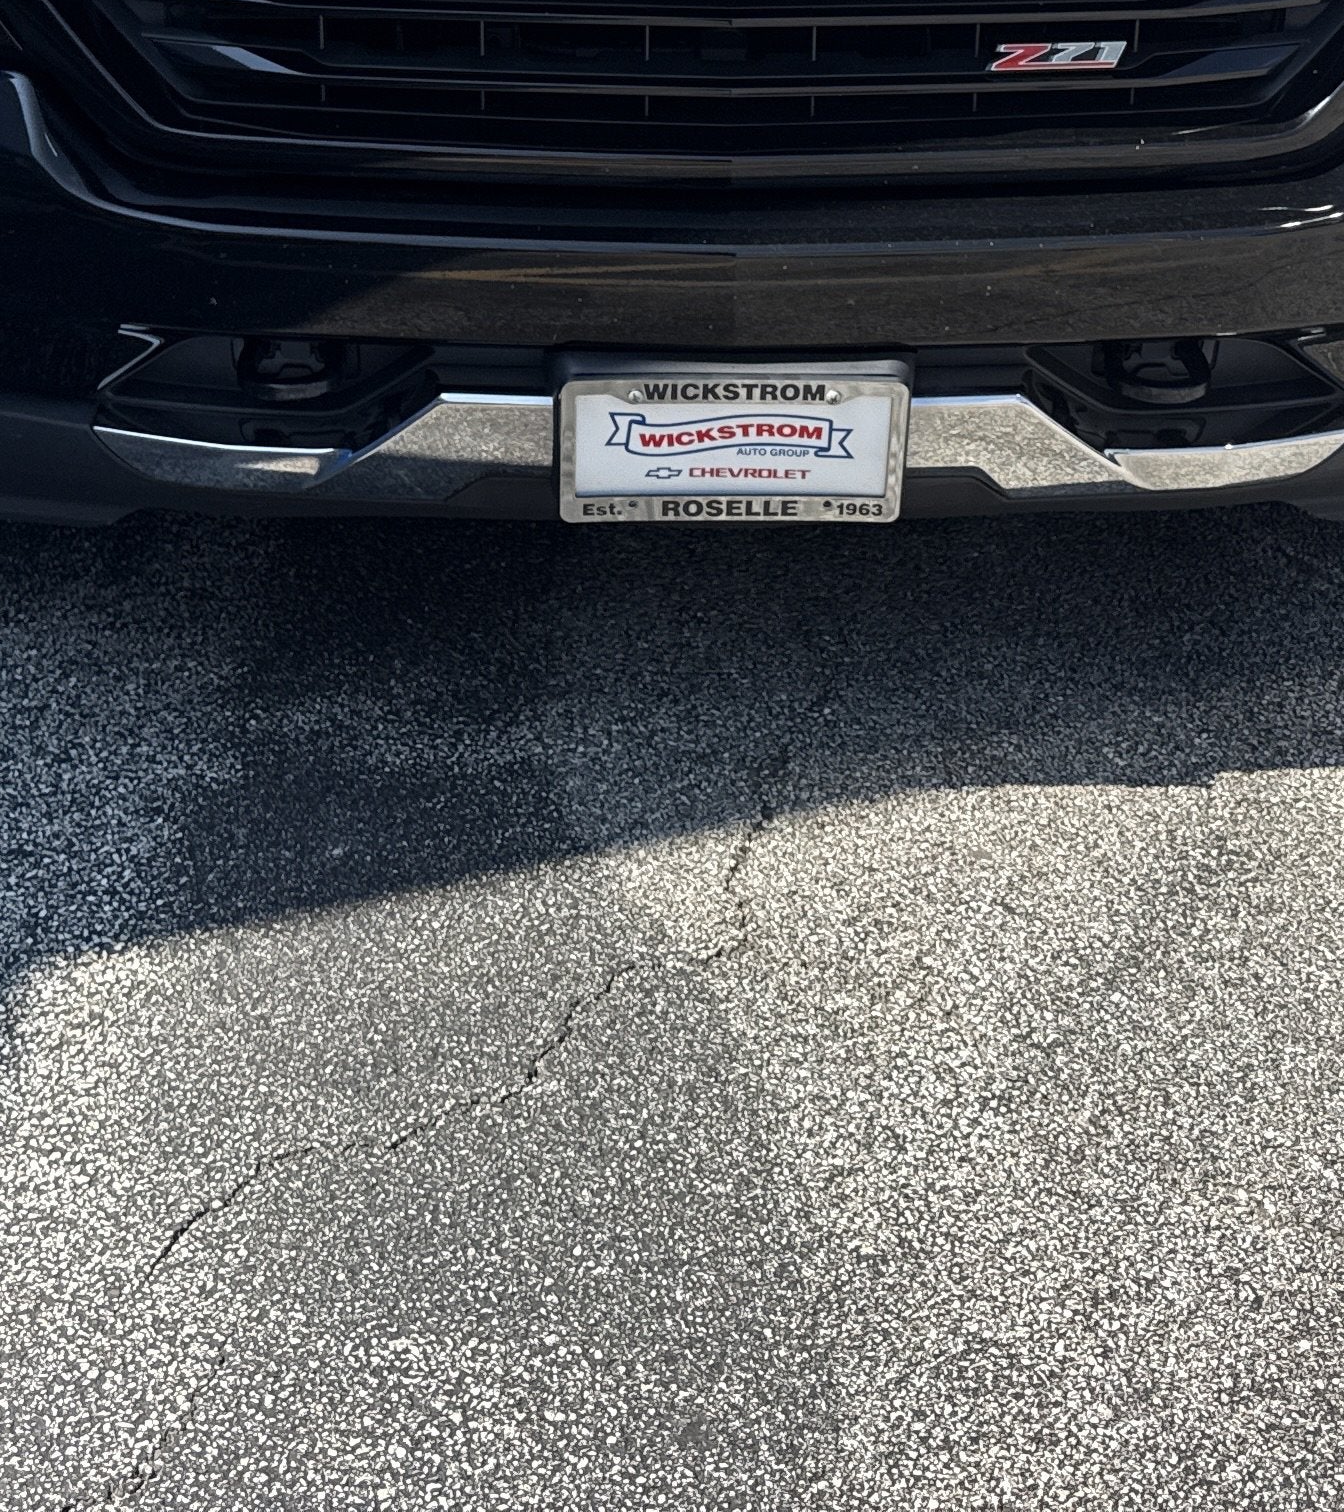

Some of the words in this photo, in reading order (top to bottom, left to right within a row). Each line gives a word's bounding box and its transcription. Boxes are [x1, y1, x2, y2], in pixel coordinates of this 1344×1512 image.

[986, 41, 1128, 71] Z71
[643, 383, 826, 402] WICKSTROM
[639, 423, 823, 448] WICKSTROM
[736, 448, 767, 457] AUTO
[770, 449, 810, 458] GROUP
[688, 467, 811, 480] CHEVROLET
[582, 503, 623, 517] Est.
[661, 500, 798, 518] ROSELLE
[836, 503, 884, 517] 1963
